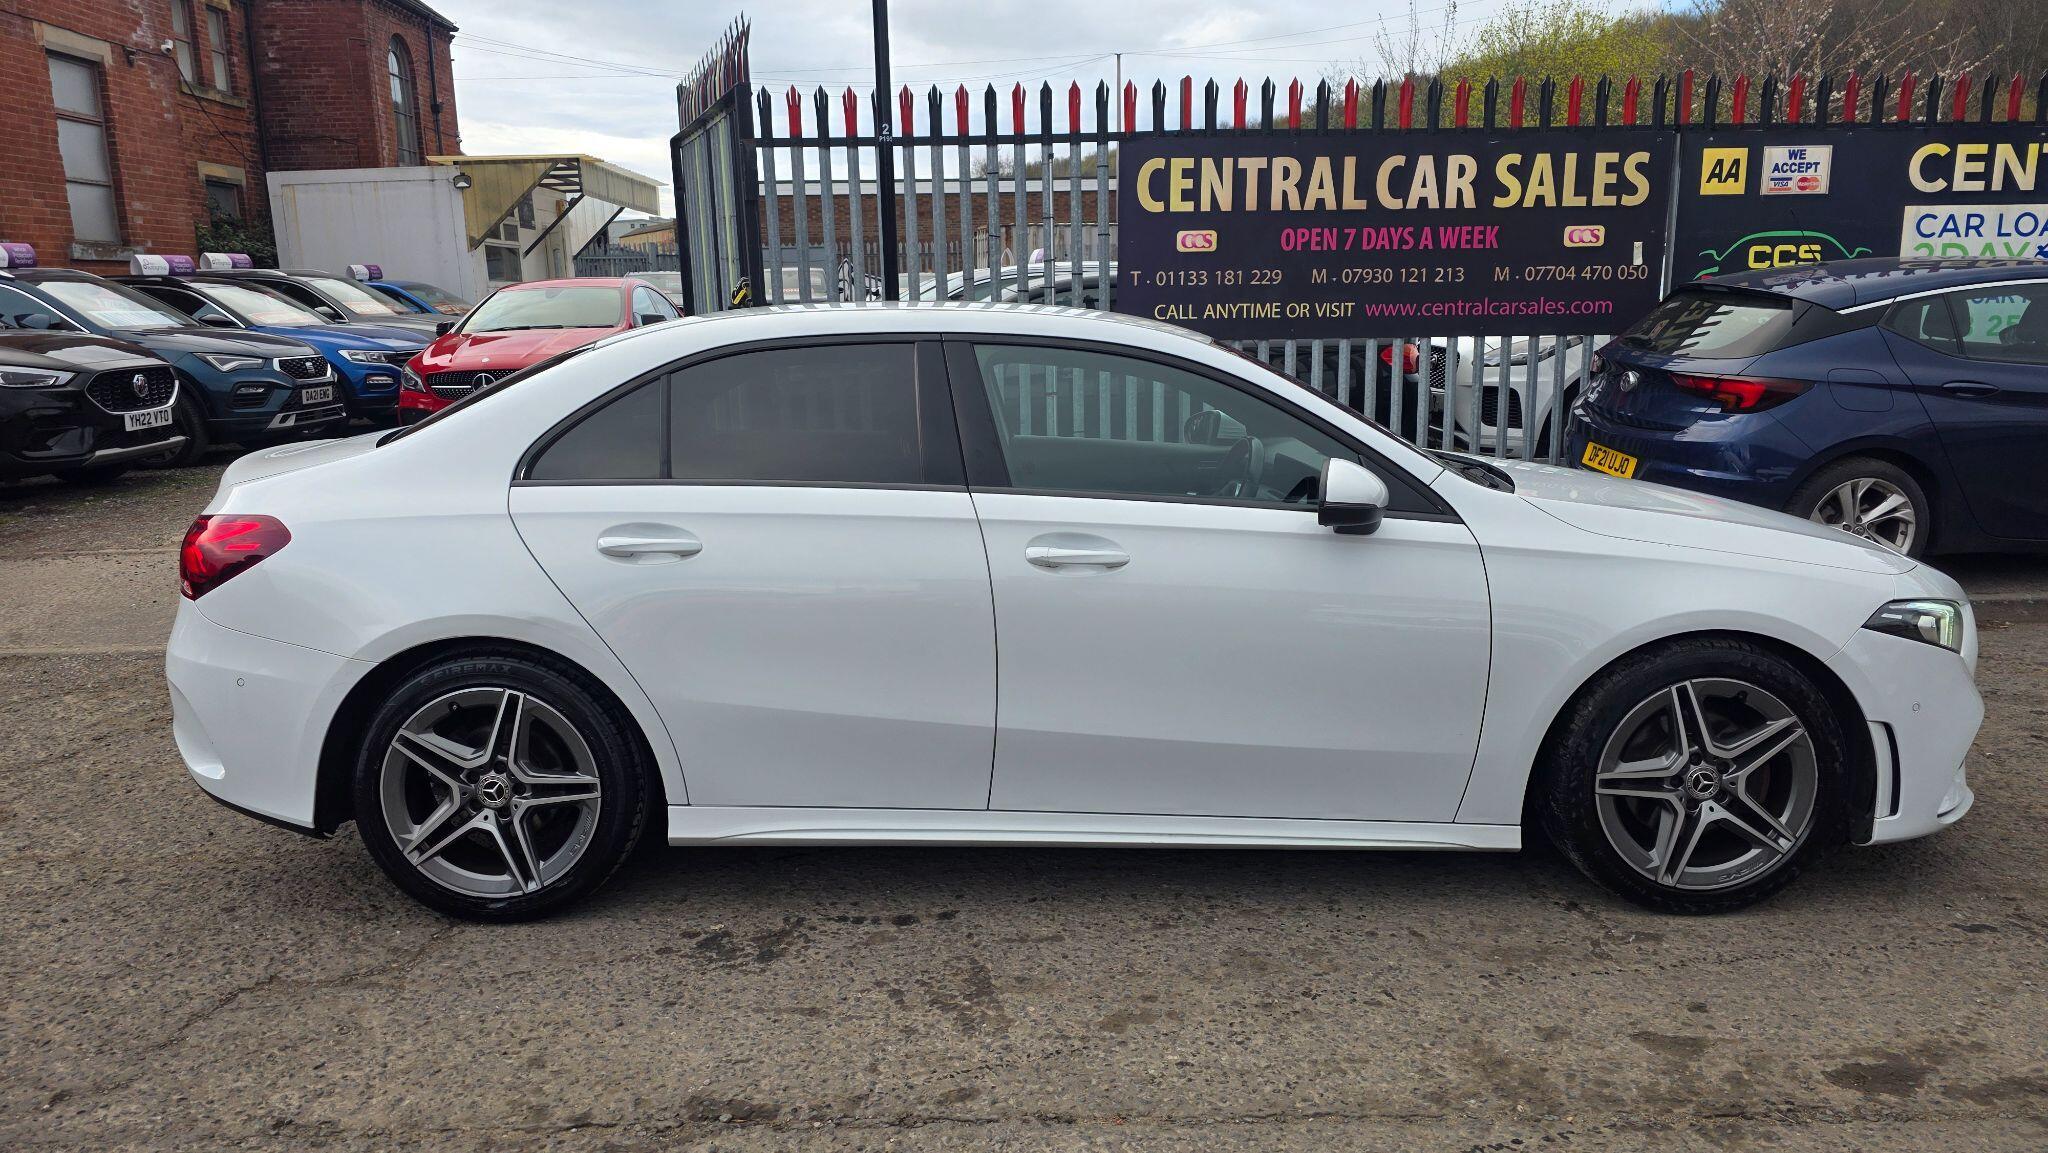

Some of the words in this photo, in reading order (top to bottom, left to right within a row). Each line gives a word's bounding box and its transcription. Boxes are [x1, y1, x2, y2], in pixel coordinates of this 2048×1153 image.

[882, 124, 889, 134] 2
[1788, 149, 1806, 160] WE
[1705, 158, 1740, 183] AA
[1772, 161, 1820, 173] ACCEPT
[1908, 143, 2048, 193] CEN
[1136, 156, 1367, 213] CENTRAL
[1376, 154, 1476, 210] CAR
[1492, 151, 1650, 208] SALES
[1915, 213, 1985, 238] CAR
[1181, 234, 1213, 248] CCS
[1281, 227, 1338, 251] OPEN
[1344, 228, 1357, 250] 7
[1362, 227, 1415, 250] DAYS
[1419, 226, 1433, 249] A
[1439, 225, 1500, 249] WEEK
[1568, 229, 1600, 244] CCS
[1748, 244, 1822, 269] CCS
[1156, 271, 1208, 286] 01133
[1215, 270, 1243, 285] 181
[1250, 269, 1282, 285] 229
[1342, 268, 1393, 283] 07930
[1400, 267, 1426, 283] 121
[1434, 267, 1465, 282] 213
[1525, 266, 1577, 281] 07704
[1581, 265, 1612, 280] 470
[1617, 265, 1648, 280] 050
[1154, 304, 1198, 320] CALL
[1203, 303, 1281, 319] ANYTIME
[1286, 302, 1310, 318] OR
[1315, 302, 1355, 318] VISIT
[1365, 297, 1613, 317] www.centralcarsales.com
[129, 412, 152, 428] YH22
[153, 409, 169, 424] VTO
